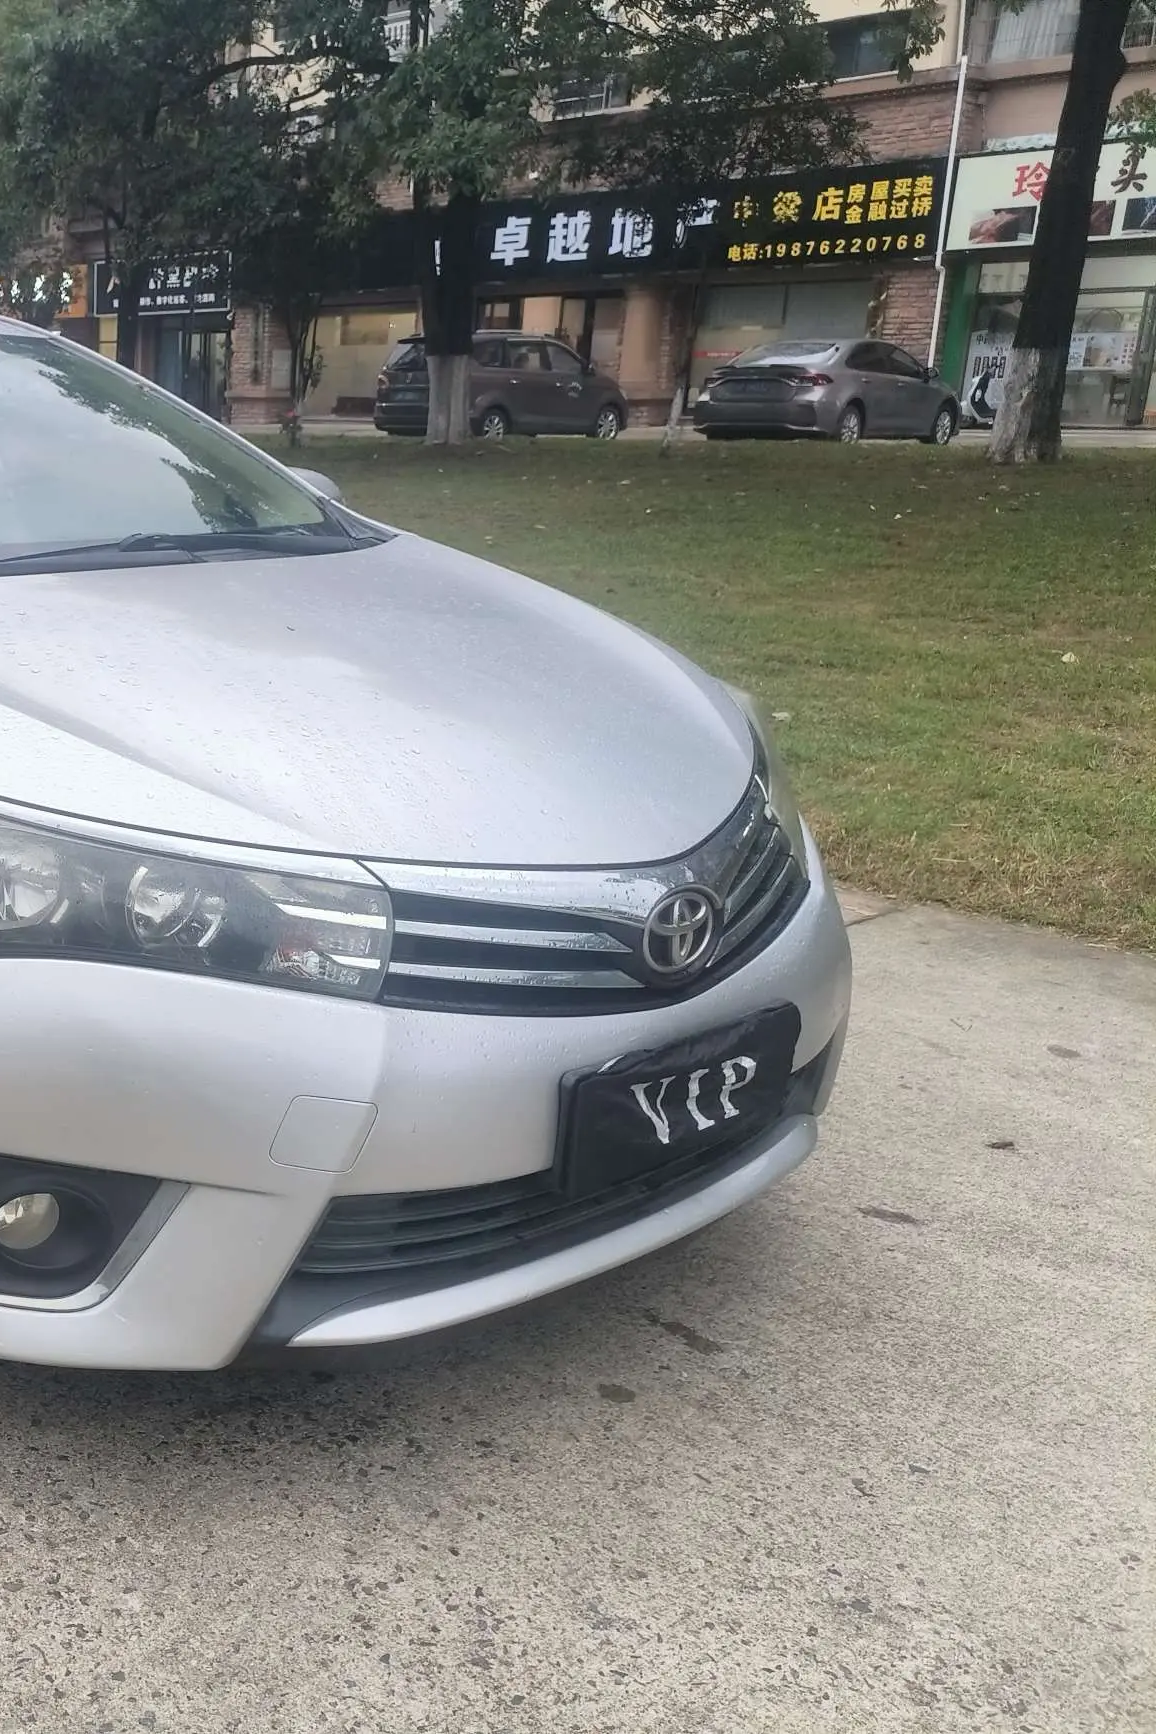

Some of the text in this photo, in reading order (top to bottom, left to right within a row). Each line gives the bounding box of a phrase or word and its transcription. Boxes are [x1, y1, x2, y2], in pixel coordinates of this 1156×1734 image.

[847, 175, 934, 203] 房屋买卖
[844, 197, 933, 224] 金融过桥
[630, 1055, 757, 1144] VIP
